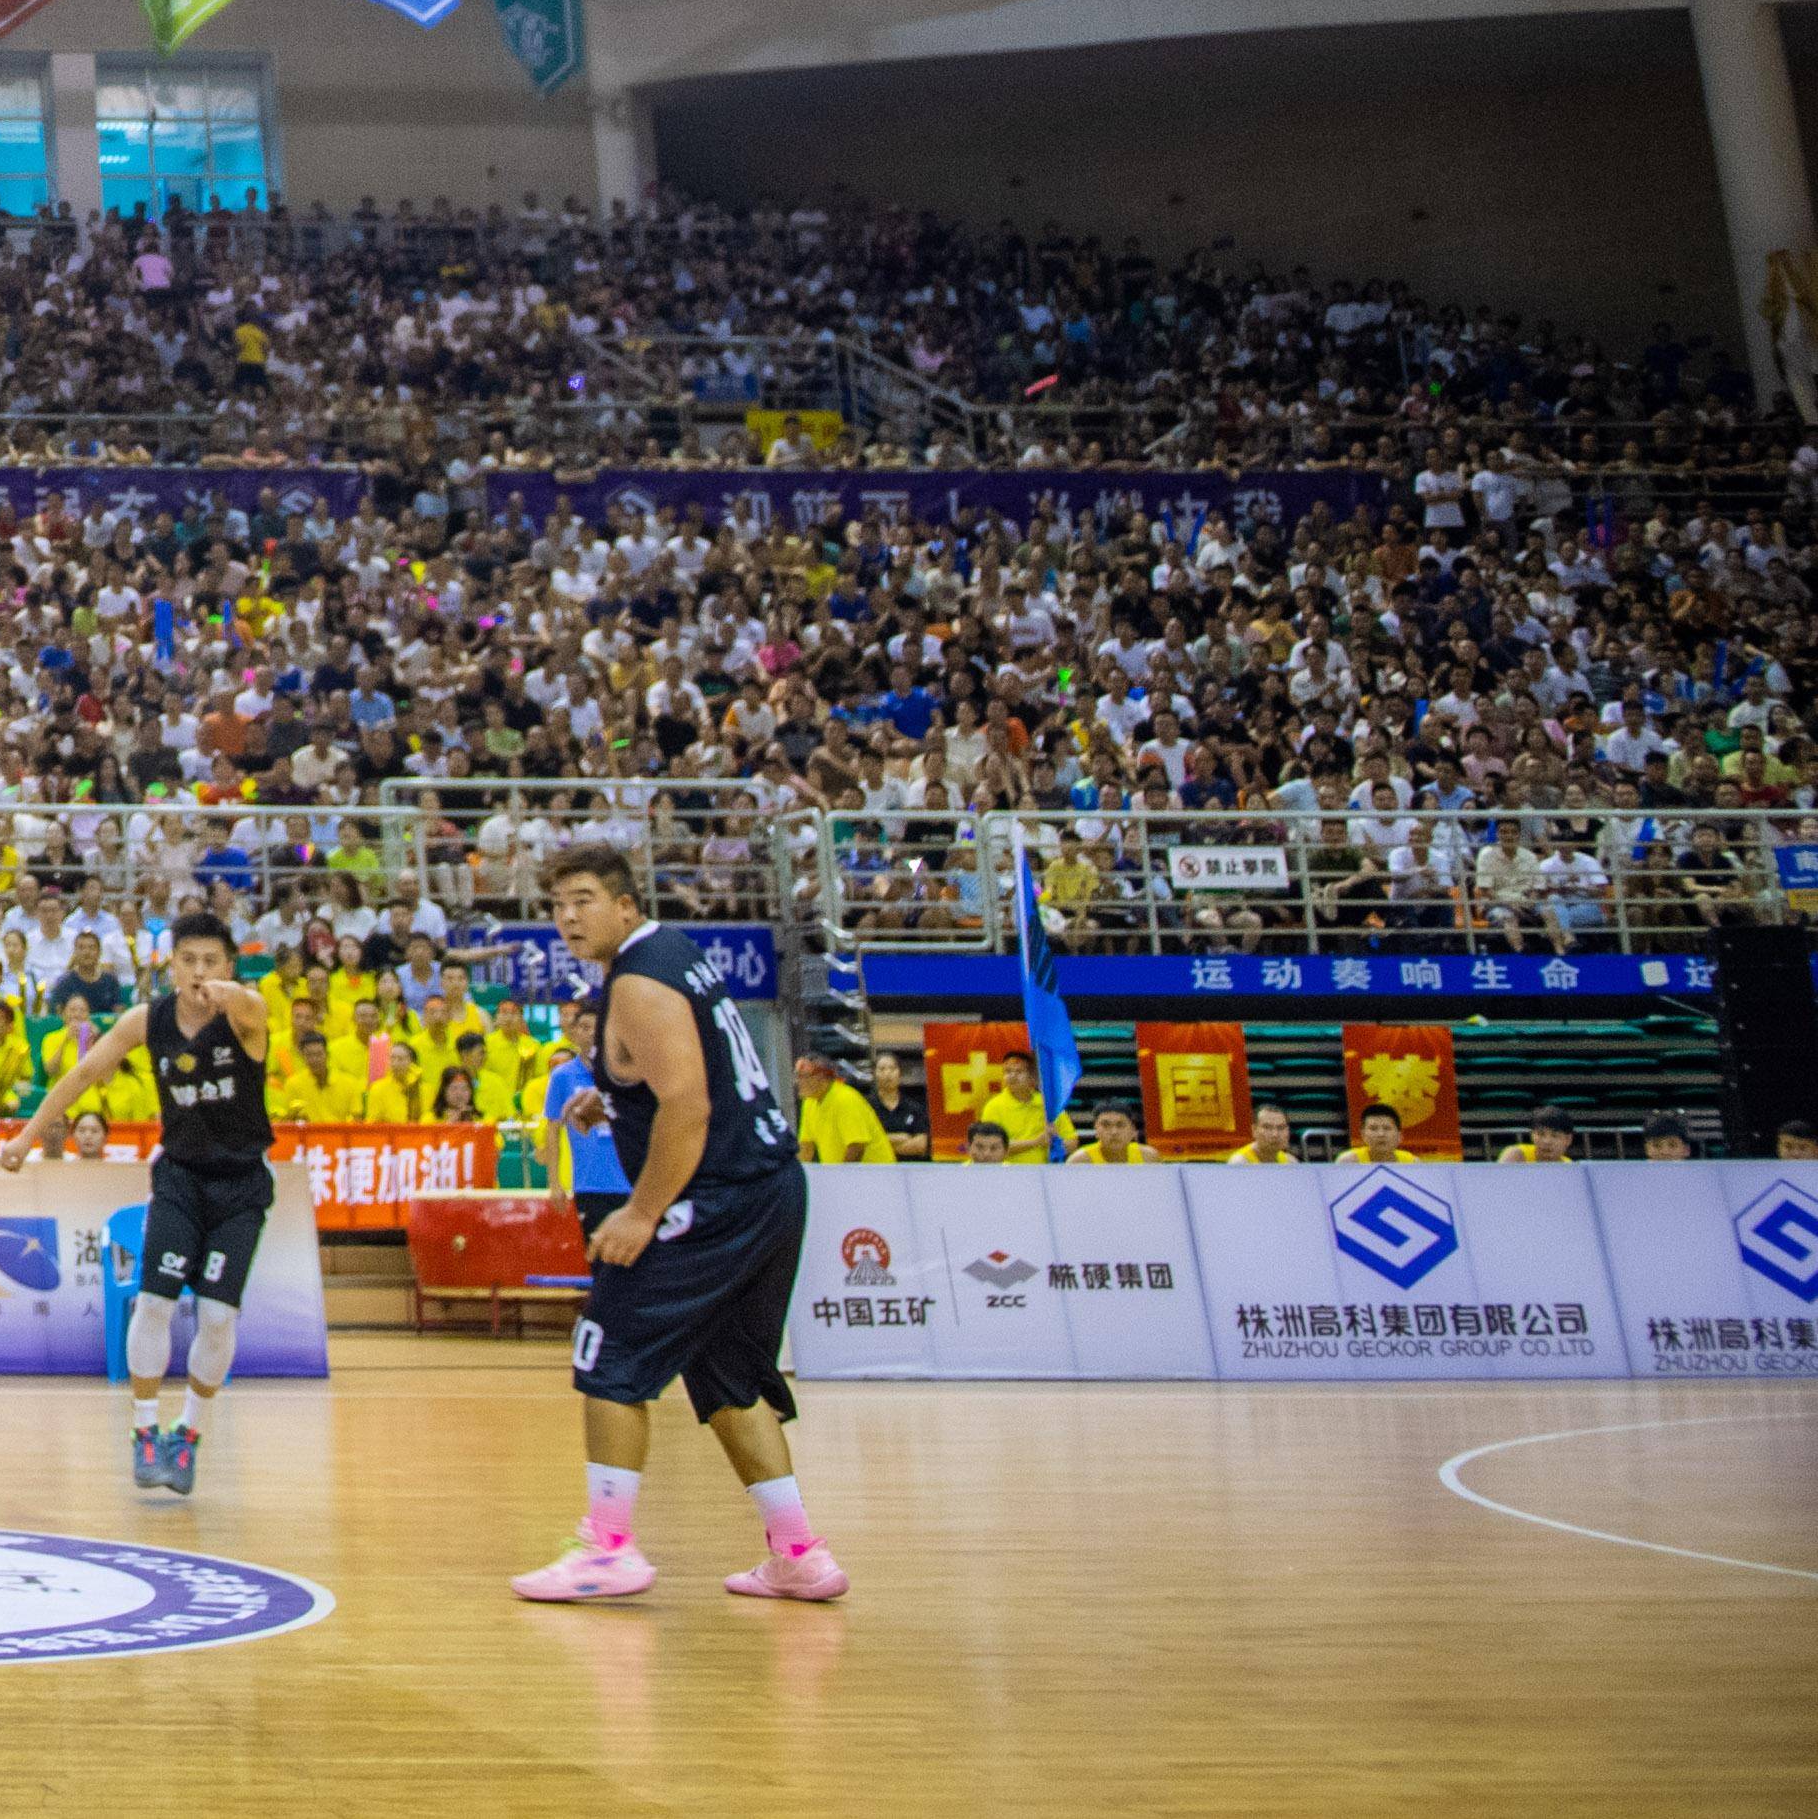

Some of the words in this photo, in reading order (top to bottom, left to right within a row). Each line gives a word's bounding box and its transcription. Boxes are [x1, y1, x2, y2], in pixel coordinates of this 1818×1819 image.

[1205, 858, 1278, 877] 禁止攀爬
[1190, 956, 1571, 991] 运动奏响生命
[1155, 1053, 1237, 1132] 国
[1048, 1262, 1175, 1290] 株硬集团
[813, 1297, 936, 1328] 中国五矿
[986, 1295, 1027, 1309] ZCC
[1237, 1303, 1589, 1338] 株洲高科集团有限公司
[1242, 1340, 1339, 1359] ZHUZHOU
[1347, 1339, 1434, 1359] GECKOR
[1441, 1338, 1512, 1358] GROUP
[1653, 1353, 1749, 1372] ZHUZHOU
